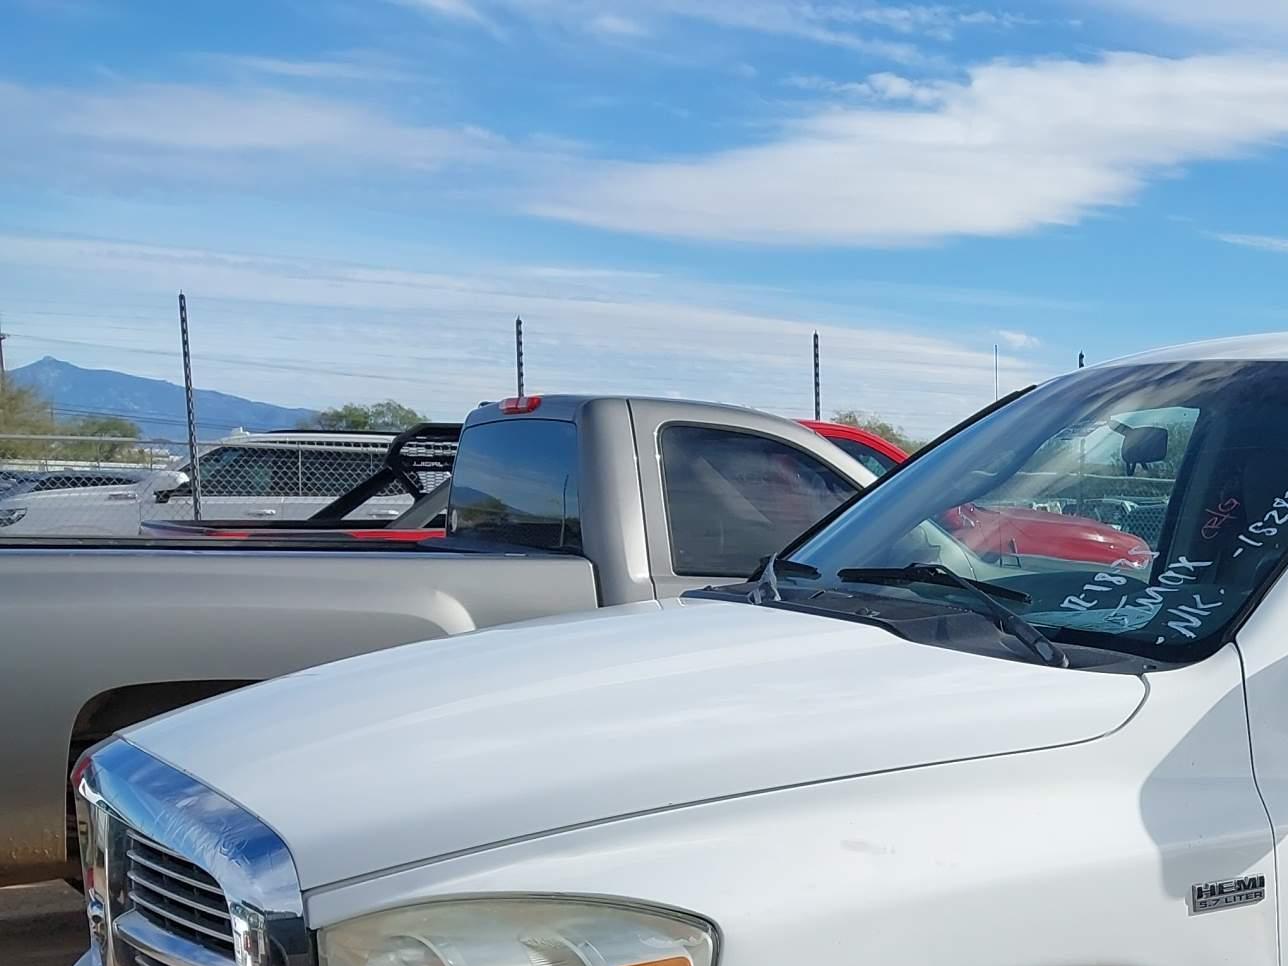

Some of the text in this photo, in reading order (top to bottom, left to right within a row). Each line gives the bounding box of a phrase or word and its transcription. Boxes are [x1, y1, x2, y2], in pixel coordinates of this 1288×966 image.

[1196, 875, 1265, 900] HEMI
[1199, 891, 1263, 909] 5.7 LITER
